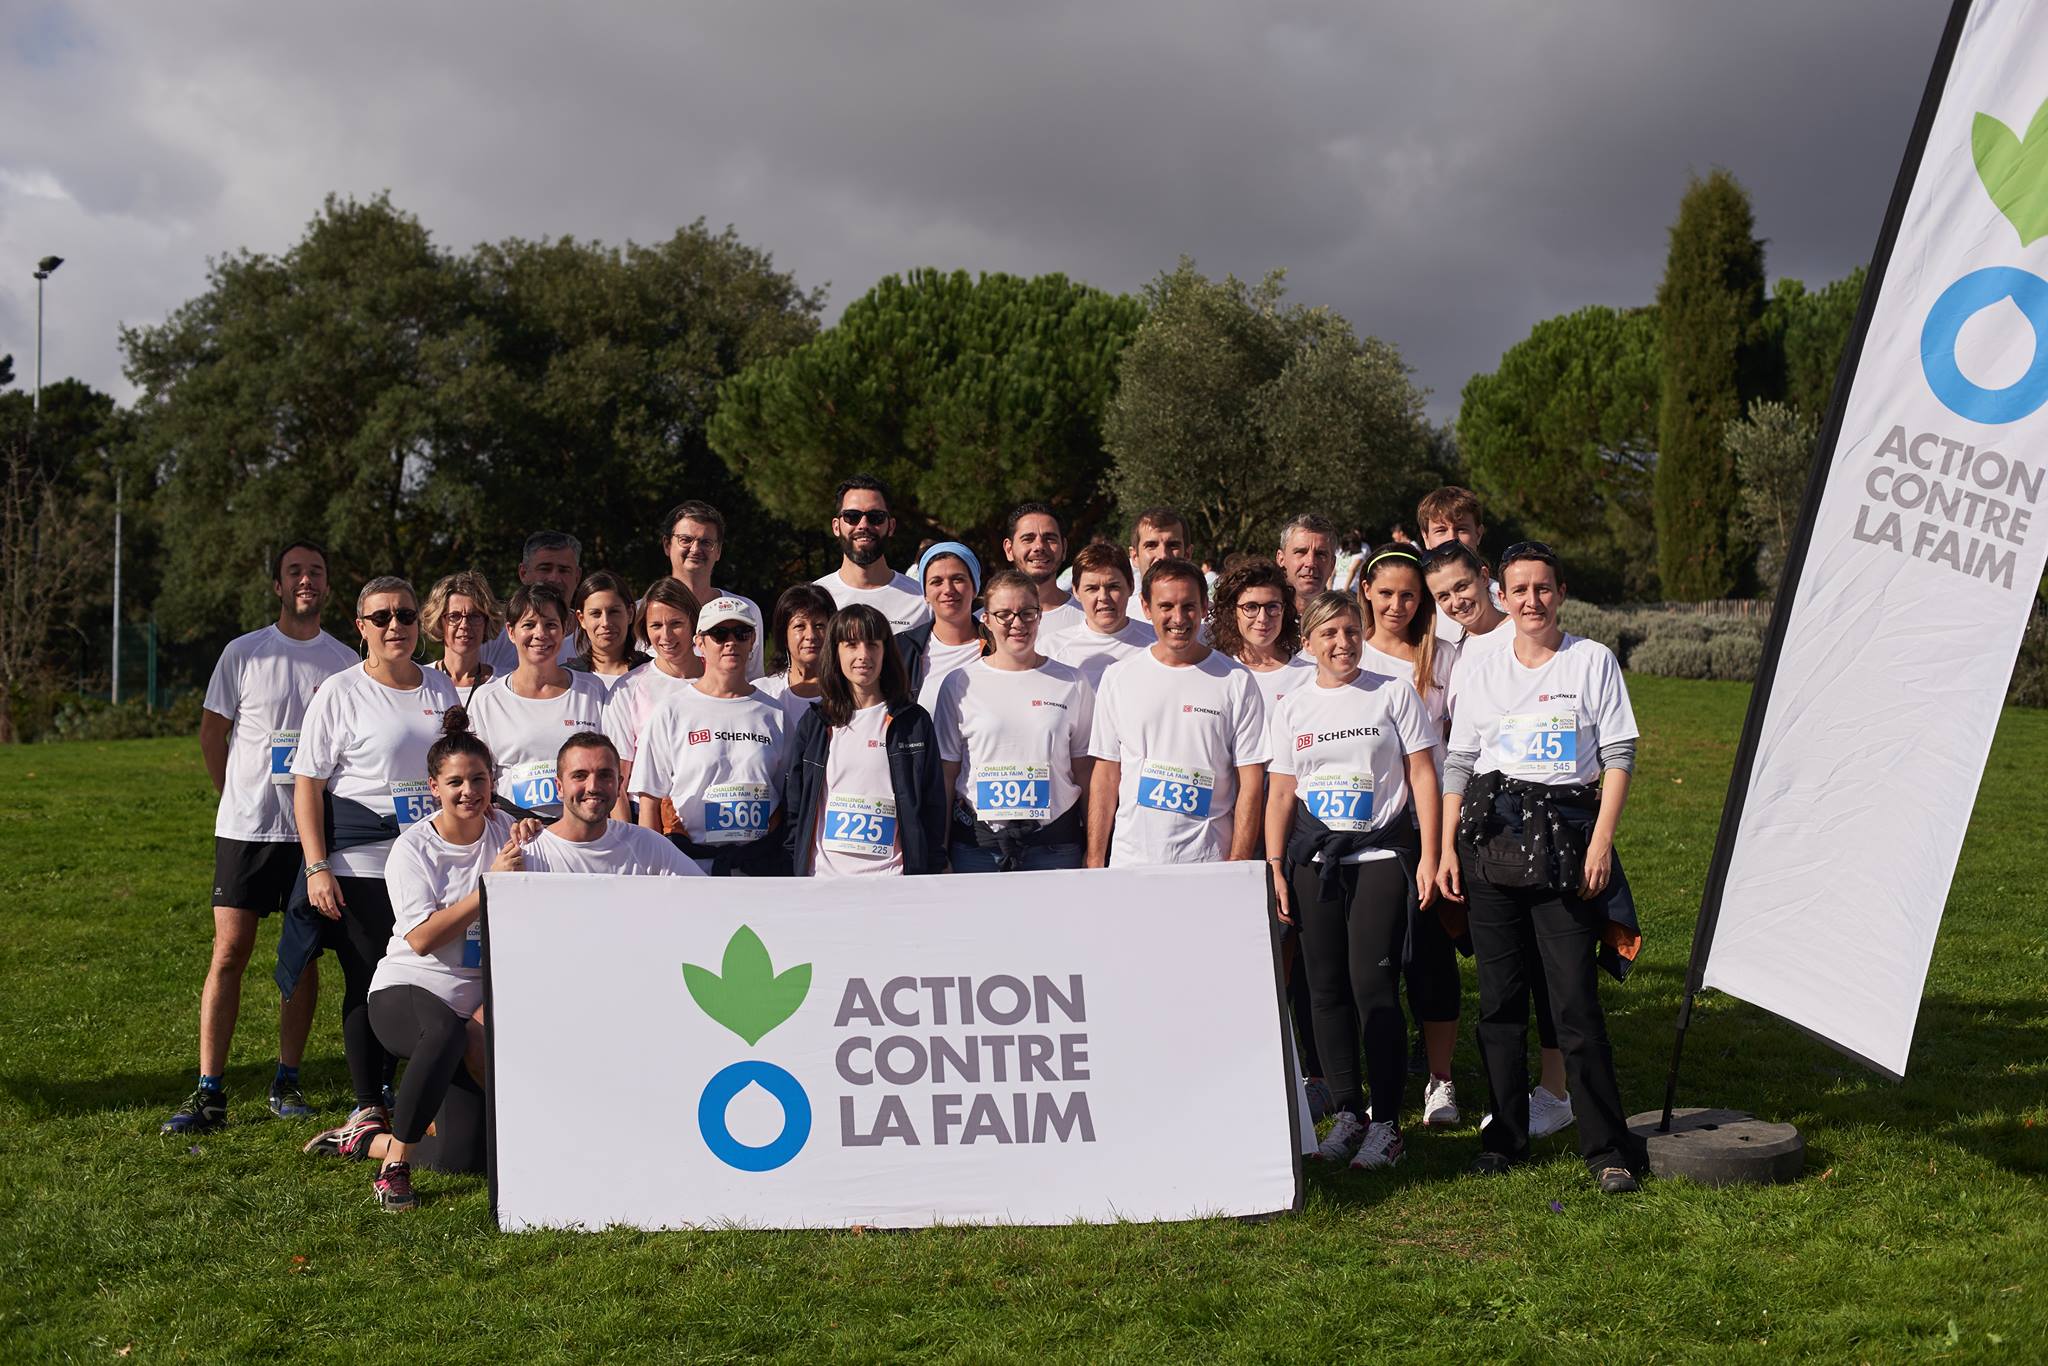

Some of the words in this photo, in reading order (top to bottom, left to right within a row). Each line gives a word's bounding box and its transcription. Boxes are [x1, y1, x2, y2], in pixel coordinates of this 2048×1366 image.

[1873, 424, 2046, 504] ACTION
[1866, 466, 2032, 546] CONTRE
[1852, 504, 1903, 552] LA
[1912, 520, 2016, 590] FAIM
[1194, 707, 1220, 715] SCHENKER
[690, 731, 709, 744] DB
[714, 732, 772, 745] SCHENKER
[1297, 735, 1312, 748] DB
[1318, 728, 1380, 742] SCHENKER
[1145, 768, 1166, 776] CONTRE
[1554, 762, 1570, 770] 545
[524, 778, 555, 804] 40
[989, 781, 1038, 807] 394
[1148, 781, 1199, 812] 433
[408, 797, 434, 821] 55
[718, 802, 761, 828] 566
[1316, 792, 1361, 817] 257
[834, 812, 883, 842] 225
[1353, 821, 1366, 829] 257
[872, 846, 888, 854] 225
[834, 974, 1086, 1027] ACTION
[835, 1033, 1090, 1086] CONTRE
[840, 1095, 921, 1146] LA
[932, 1092, 1096, 1145] FAIM
